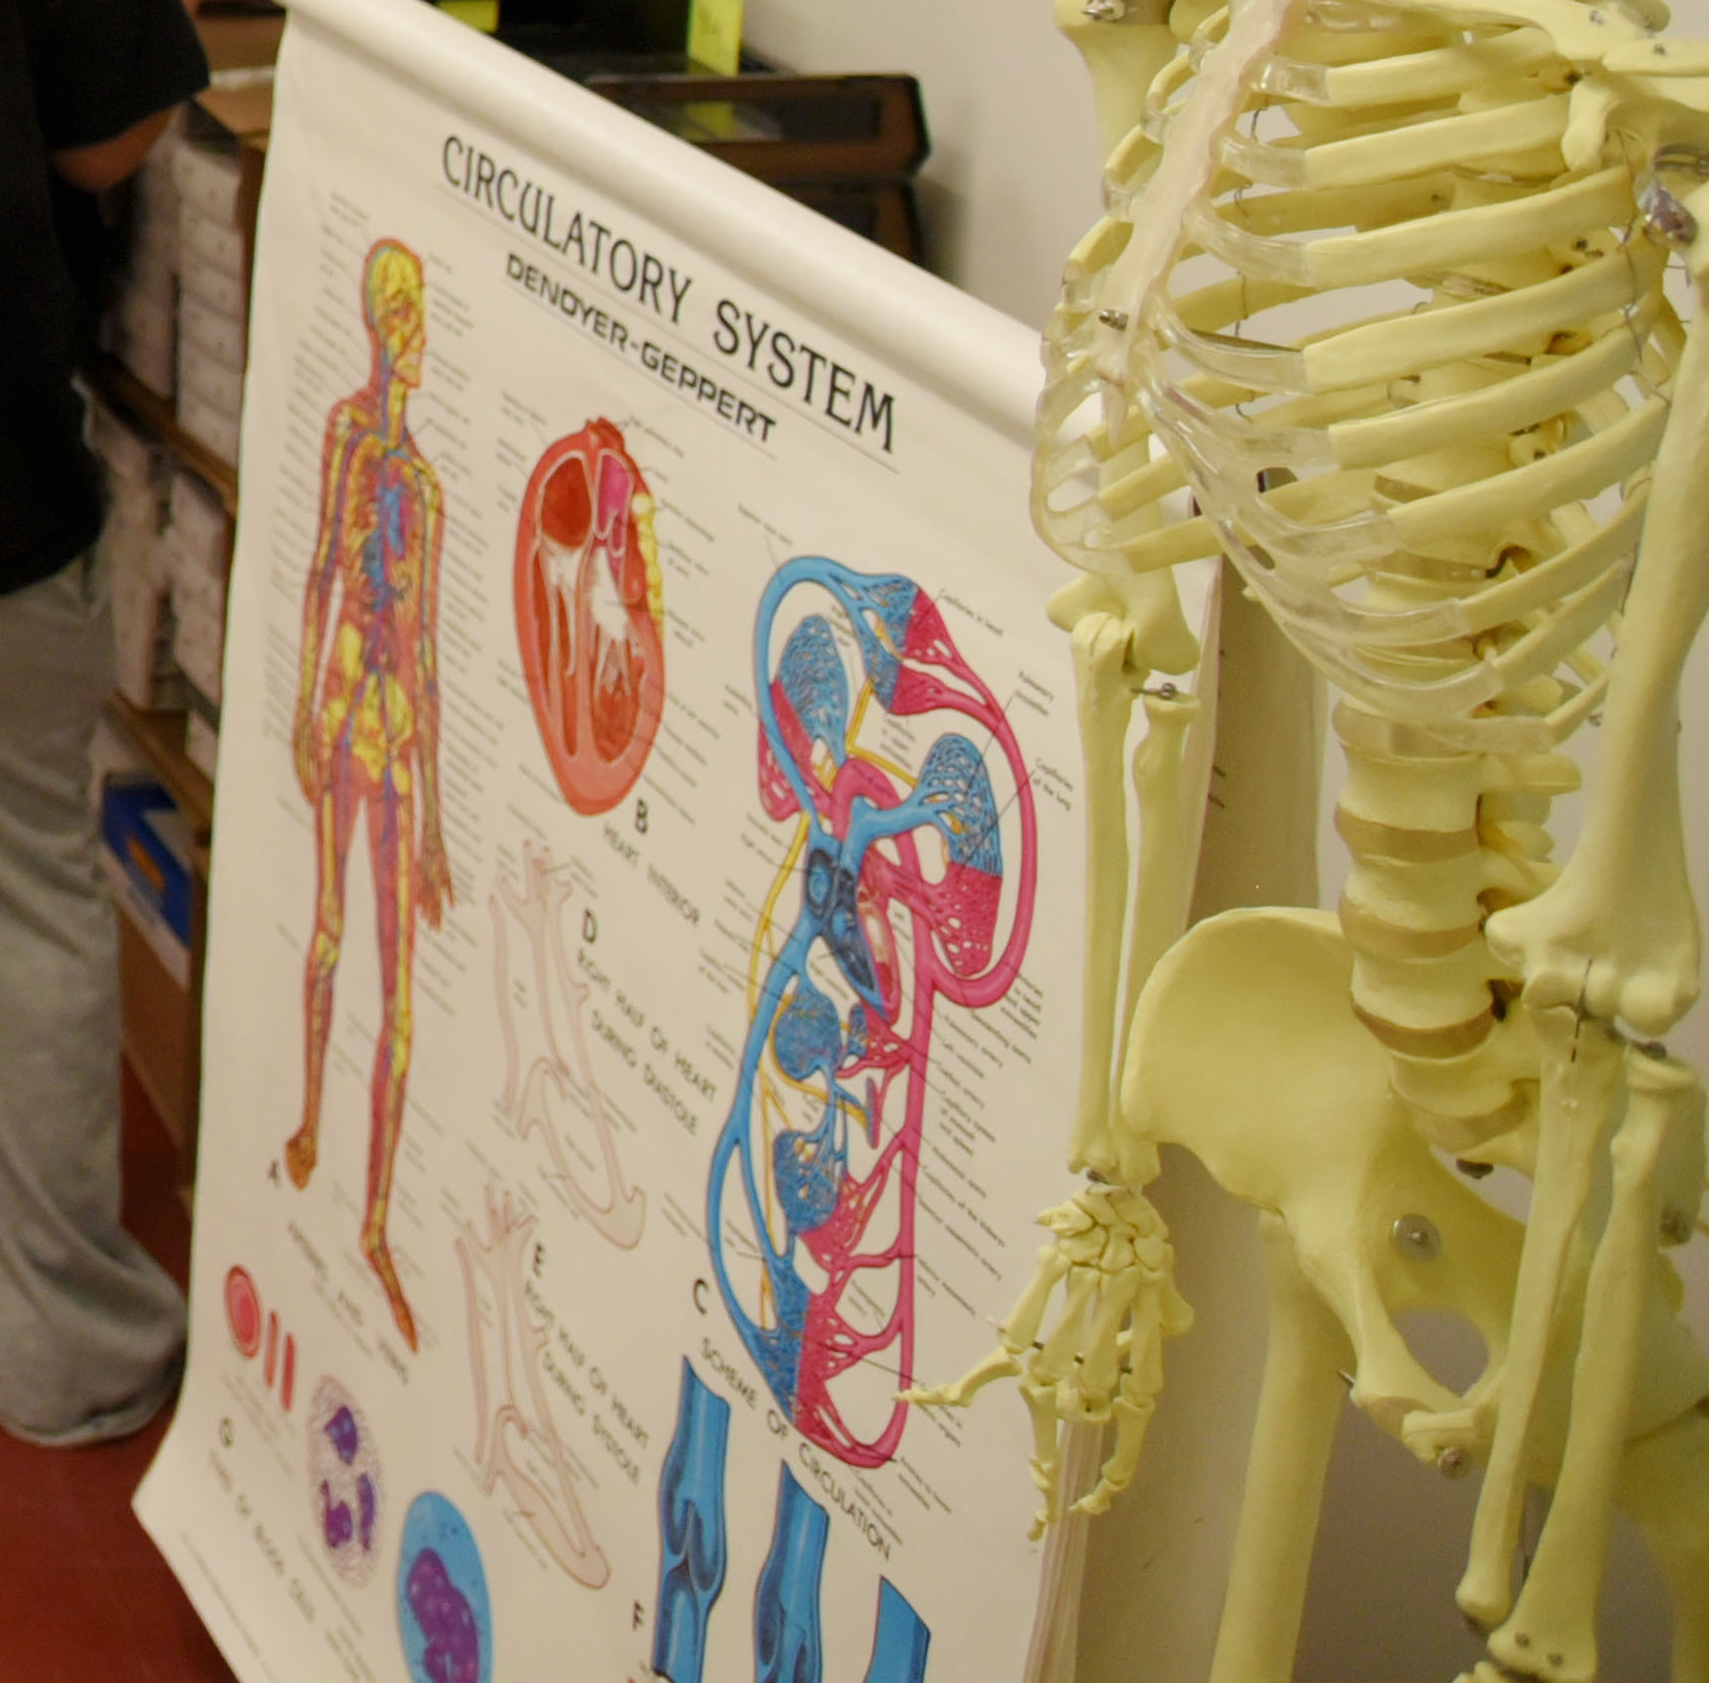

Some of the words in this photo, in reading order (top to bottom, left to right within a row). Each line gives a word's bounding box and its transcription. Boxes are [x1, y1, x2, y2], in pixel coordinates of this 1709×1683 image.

[443, 133, 692, 324] CIRCULATORY
[713, 299, 897, 455] SYSTEM
[505, 253, 777, 443] DENOYER-GEPPERT
[635, 798, 649, 835] B
[582, 908, 598, 945] D
[693, 1277, 710, 1316] C
[766, 1408, 789, 1439] OF
[797, 1442, 892, 1562] CIRCULATION
